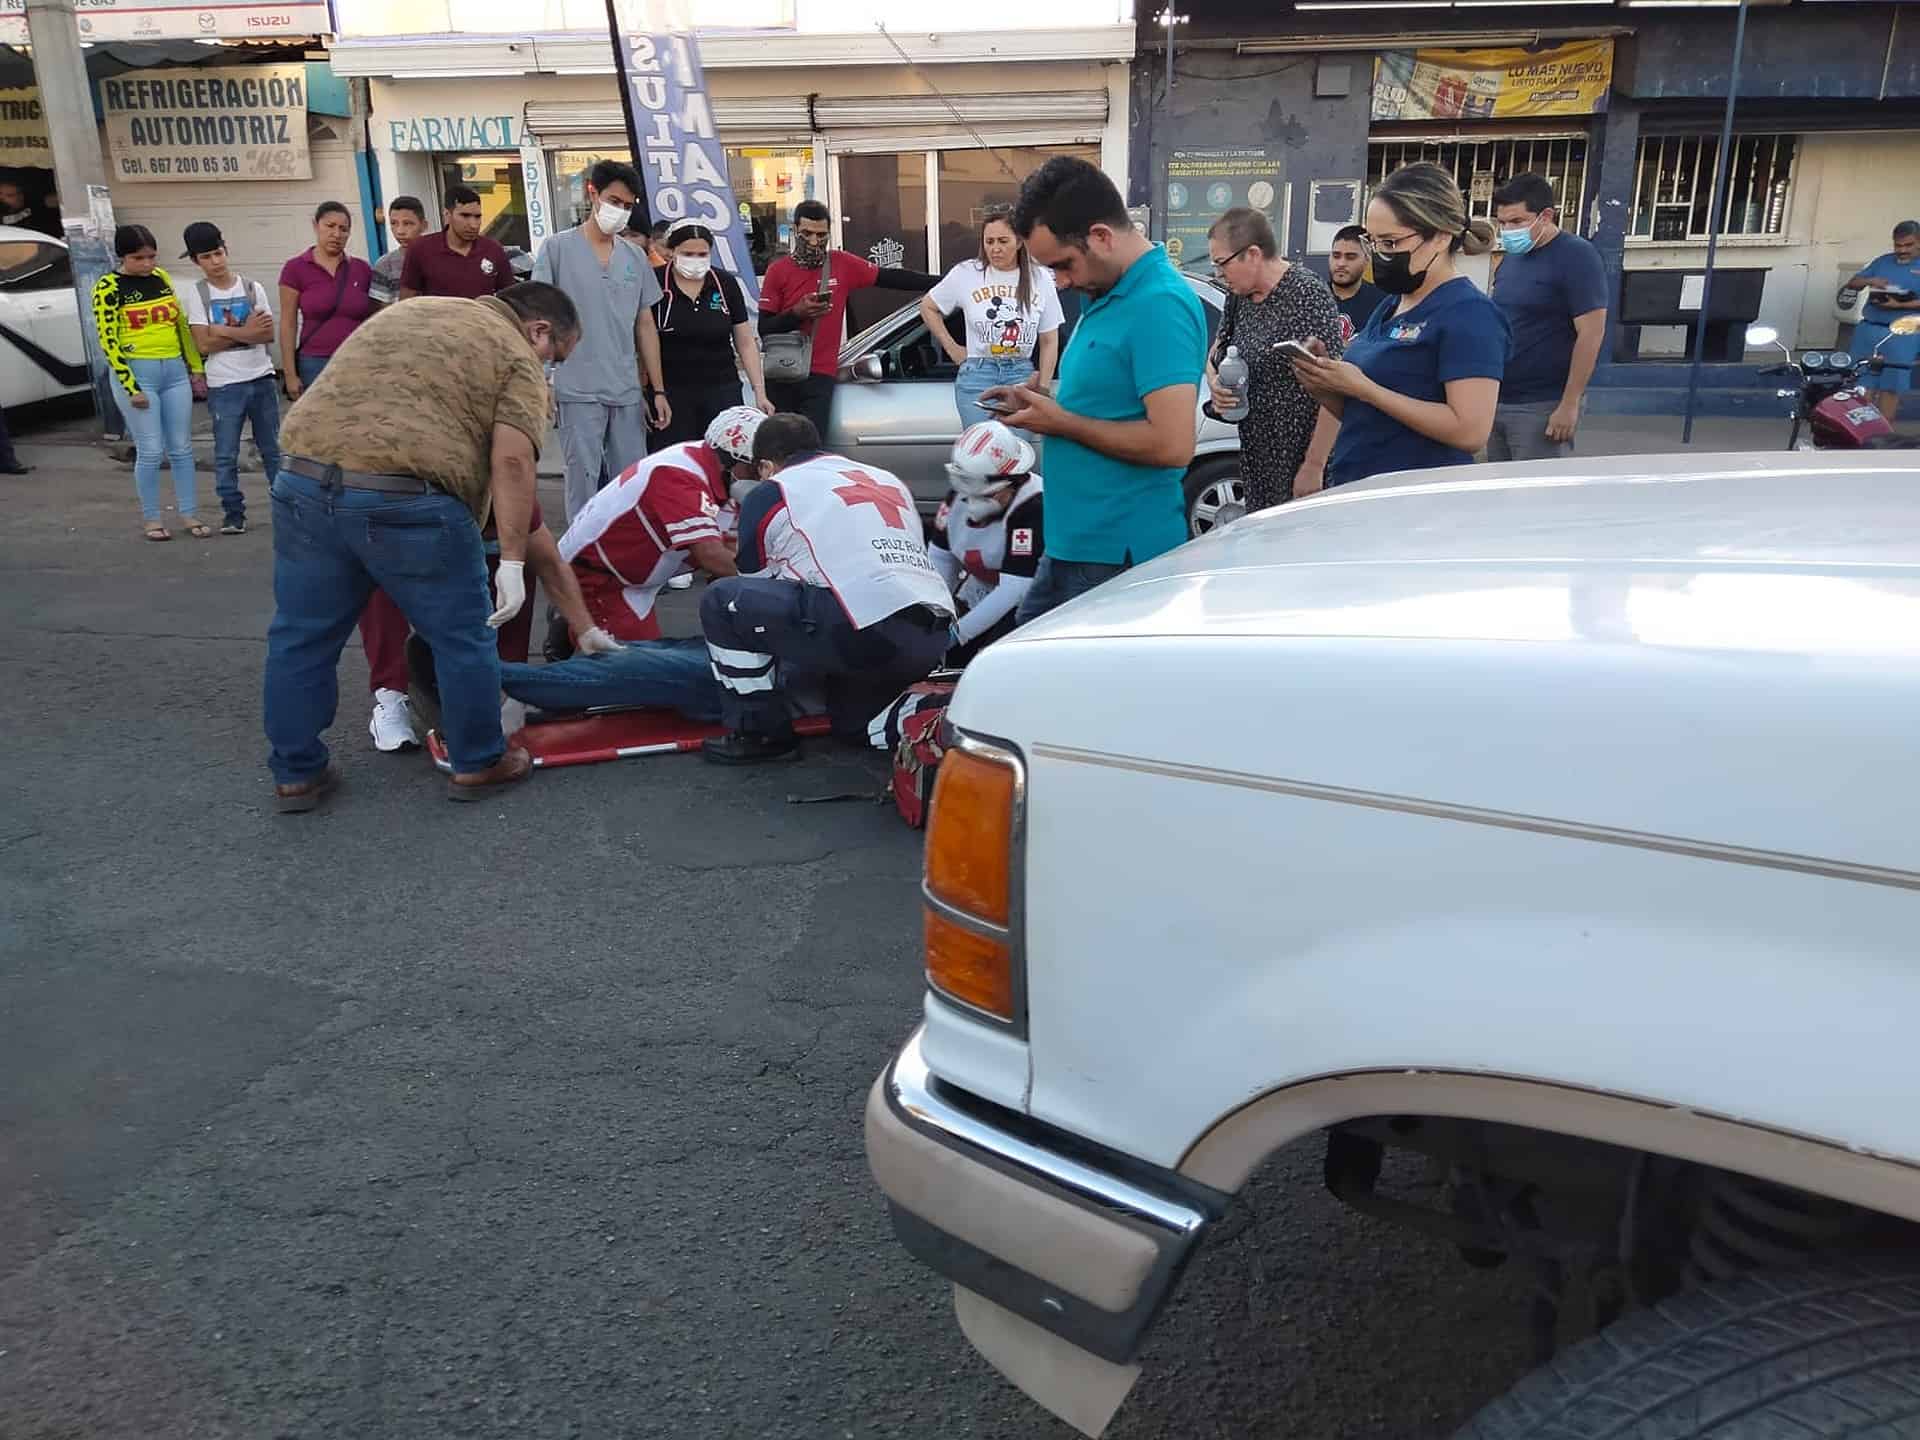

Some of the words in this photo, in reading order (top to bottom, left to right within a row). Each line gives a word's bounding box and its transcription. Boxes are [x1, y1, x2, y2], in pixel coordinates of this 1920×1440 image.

[248, 16, 290, 27] ISUZU
[106, 71, 305, 110] REFRIGERACIÓN
[131, 114, 291, 146] AUTOMOTRIZ
[122, 158, 147, 174] Cel.
[176, 156, 200, 174] 200
[223, 155, 239, 173] 30
[971, 284, 1039, 306] ORIGIL
[872, 538, 905, 551] CRUZ
[880, 552, 936, 571] MEXICAN
